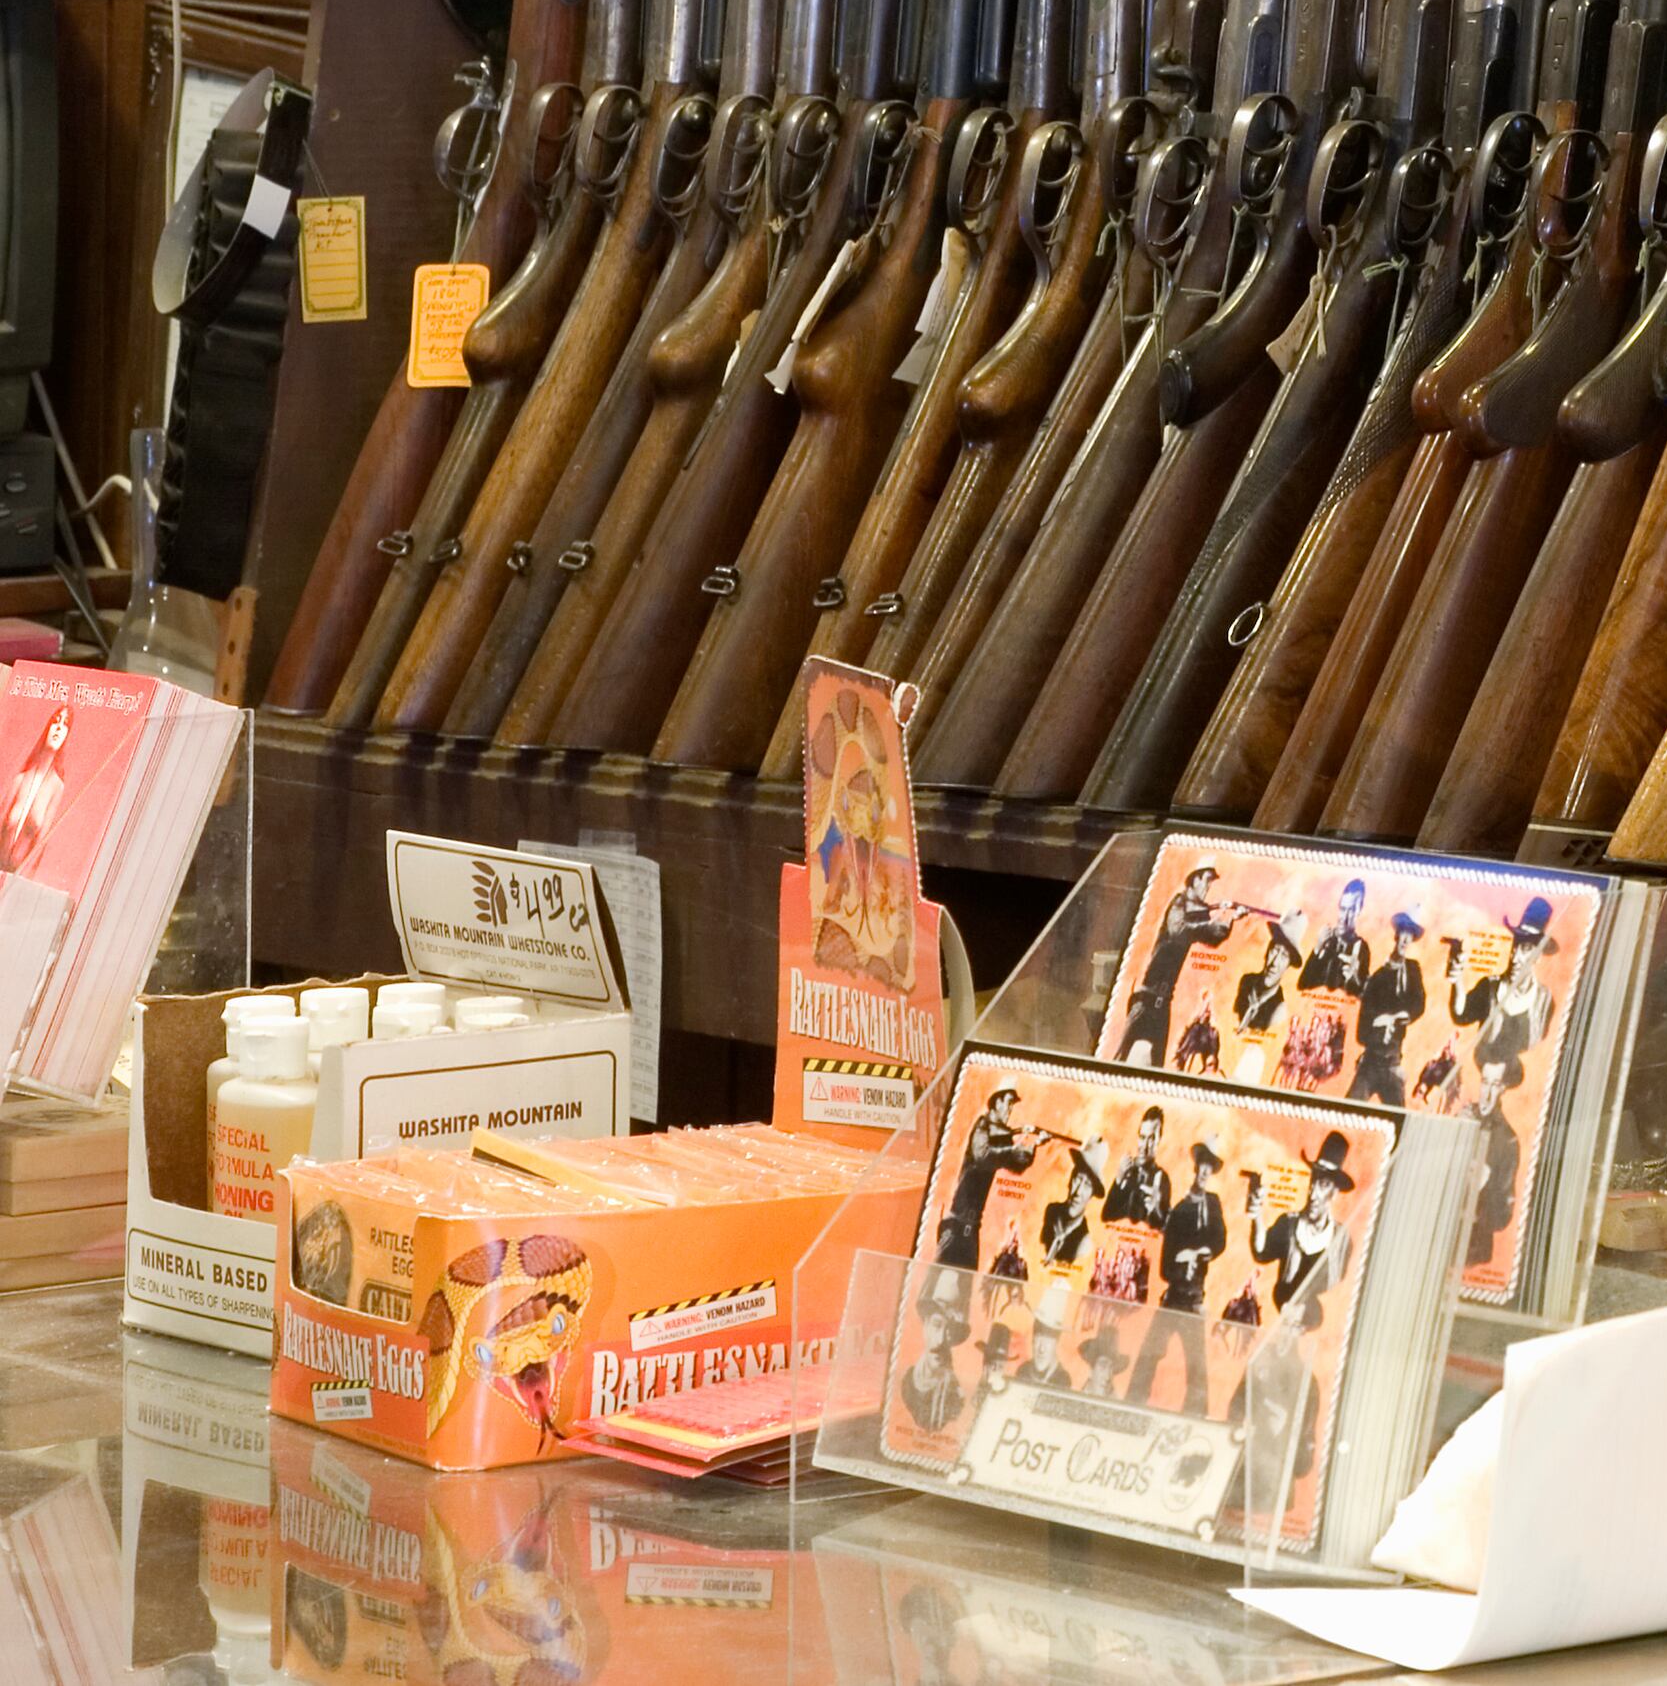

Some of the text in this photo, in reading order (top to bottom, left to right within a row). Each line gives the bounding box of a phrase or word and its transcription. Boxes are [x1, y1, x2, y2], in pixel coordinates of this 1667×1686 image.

[22, 676, 47, 699] This
[73, 682, 107, 709] Wyatt
[409, 916, 451, 939] WASHITA
[453, 925, 506, 949] MOUNTAIN
[508, 935, 568, 958] WHETSTONE
[570, 946, 591, 962] CO.
[1190, 950, 1228, 964] HONDO
[789, 967, 937, 1071] RATTLESNAKE EGGS
[862, 1087, 883, 1107] VENOM
[884, 1090, 907, 1109] HAZARD
[398, 1100, 583, 1139] WASHITA MOUNTAIN
[216, 1123, 271, 1153] SPECIAL
[214, 1182, 274, 1212] HONING
[995, 1177, 1033, 1191] HONDO
[140, 1246, 268, 1293] MINERAL BASED
[132, 1275, 219, 1309] USE ON ALL TYPES OF
[705, 1304, 733, 1321] VENOM
[735, 1295, 766, 1313] HAZARD
[656, 1311, 758, 1344] HANDLE WITH CAUTION
[283, 1300, 375, 1383] RATTLESNAKE
[376, 1334, 425, 1401] EGGS
